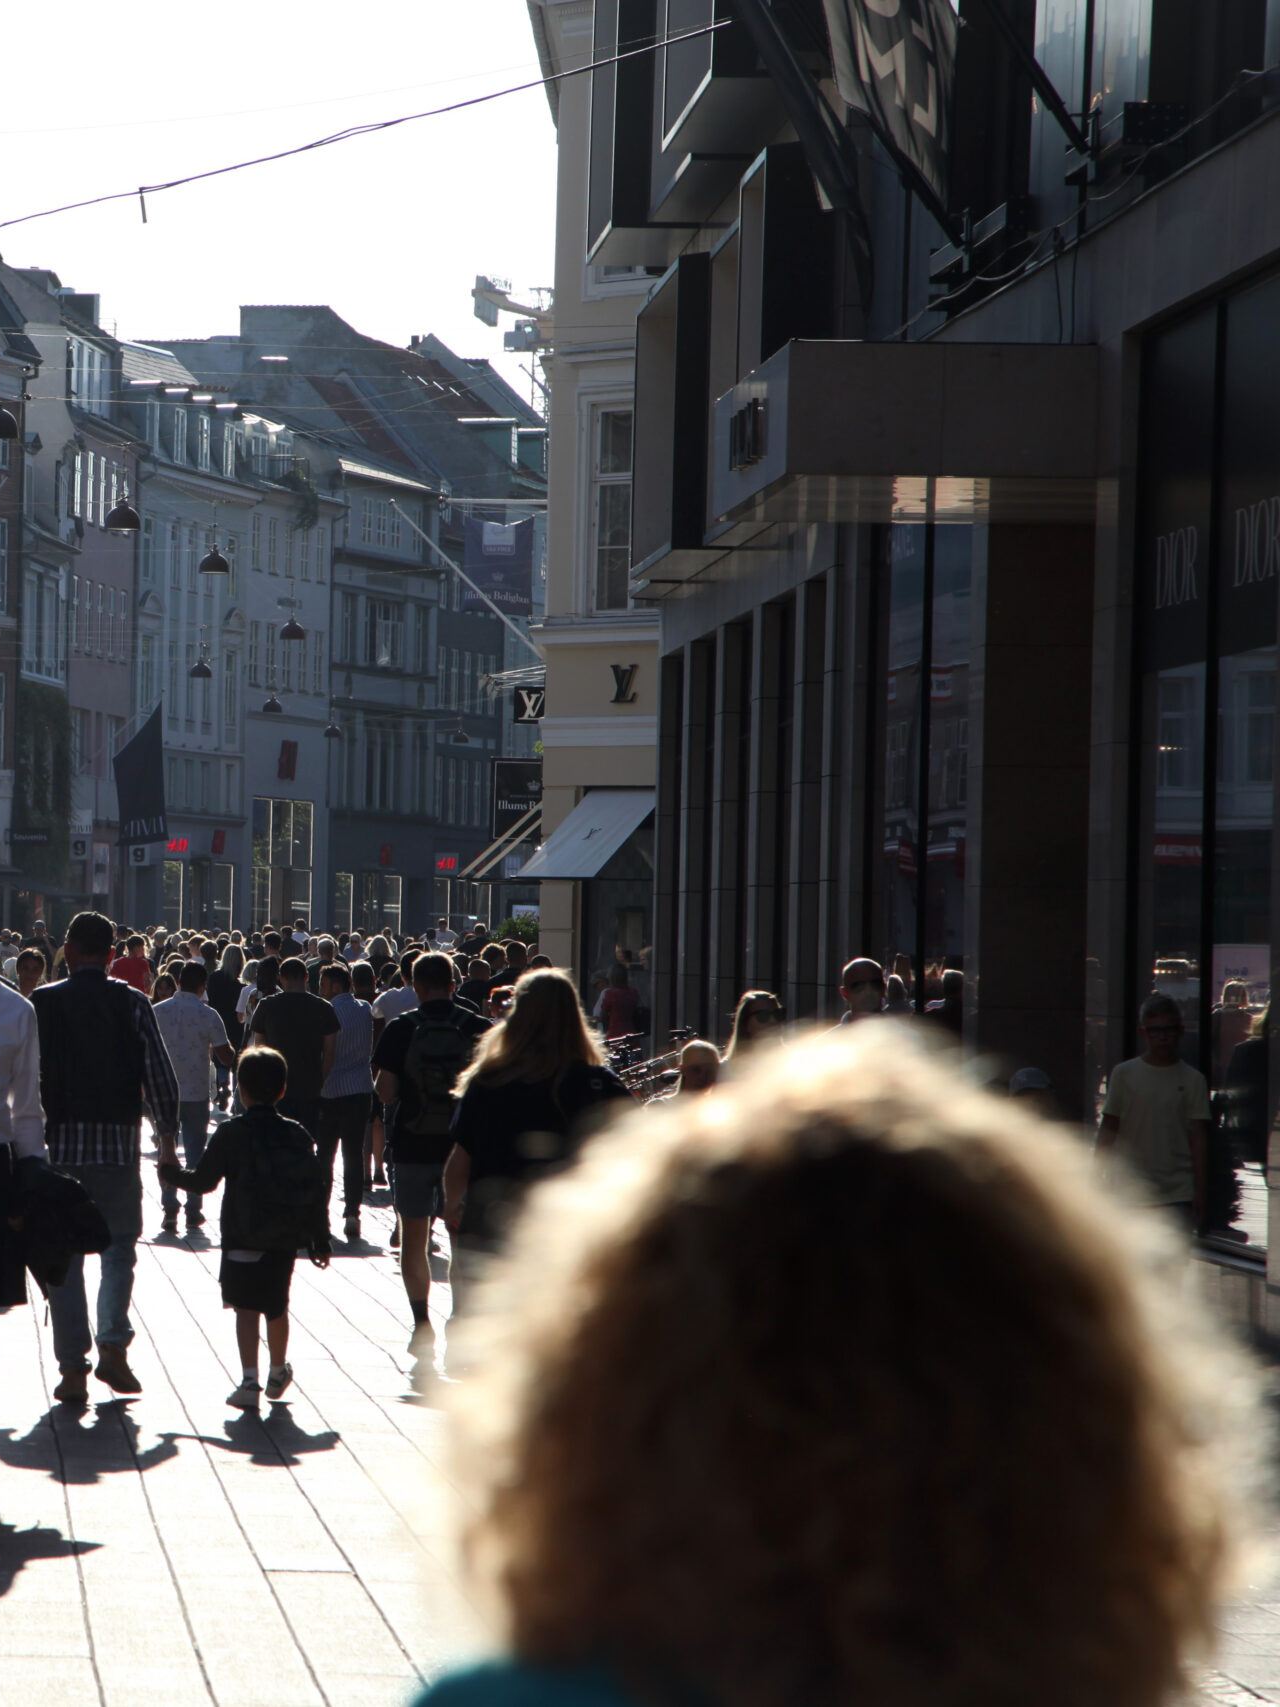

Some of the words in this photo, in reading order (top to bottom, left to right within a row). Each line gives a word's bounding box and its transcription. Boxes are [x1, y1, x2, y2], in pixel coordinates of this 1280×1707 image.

[1231, 496, 1280, 587] DIOR
[1154, 525, 1198, 610] DIOR
[610, 663, 639, 704] LV
[497, 799, 528, 811] Illums
[13, 831, 48, 841] Souvenirs
[133, 847, 145, 862] g
